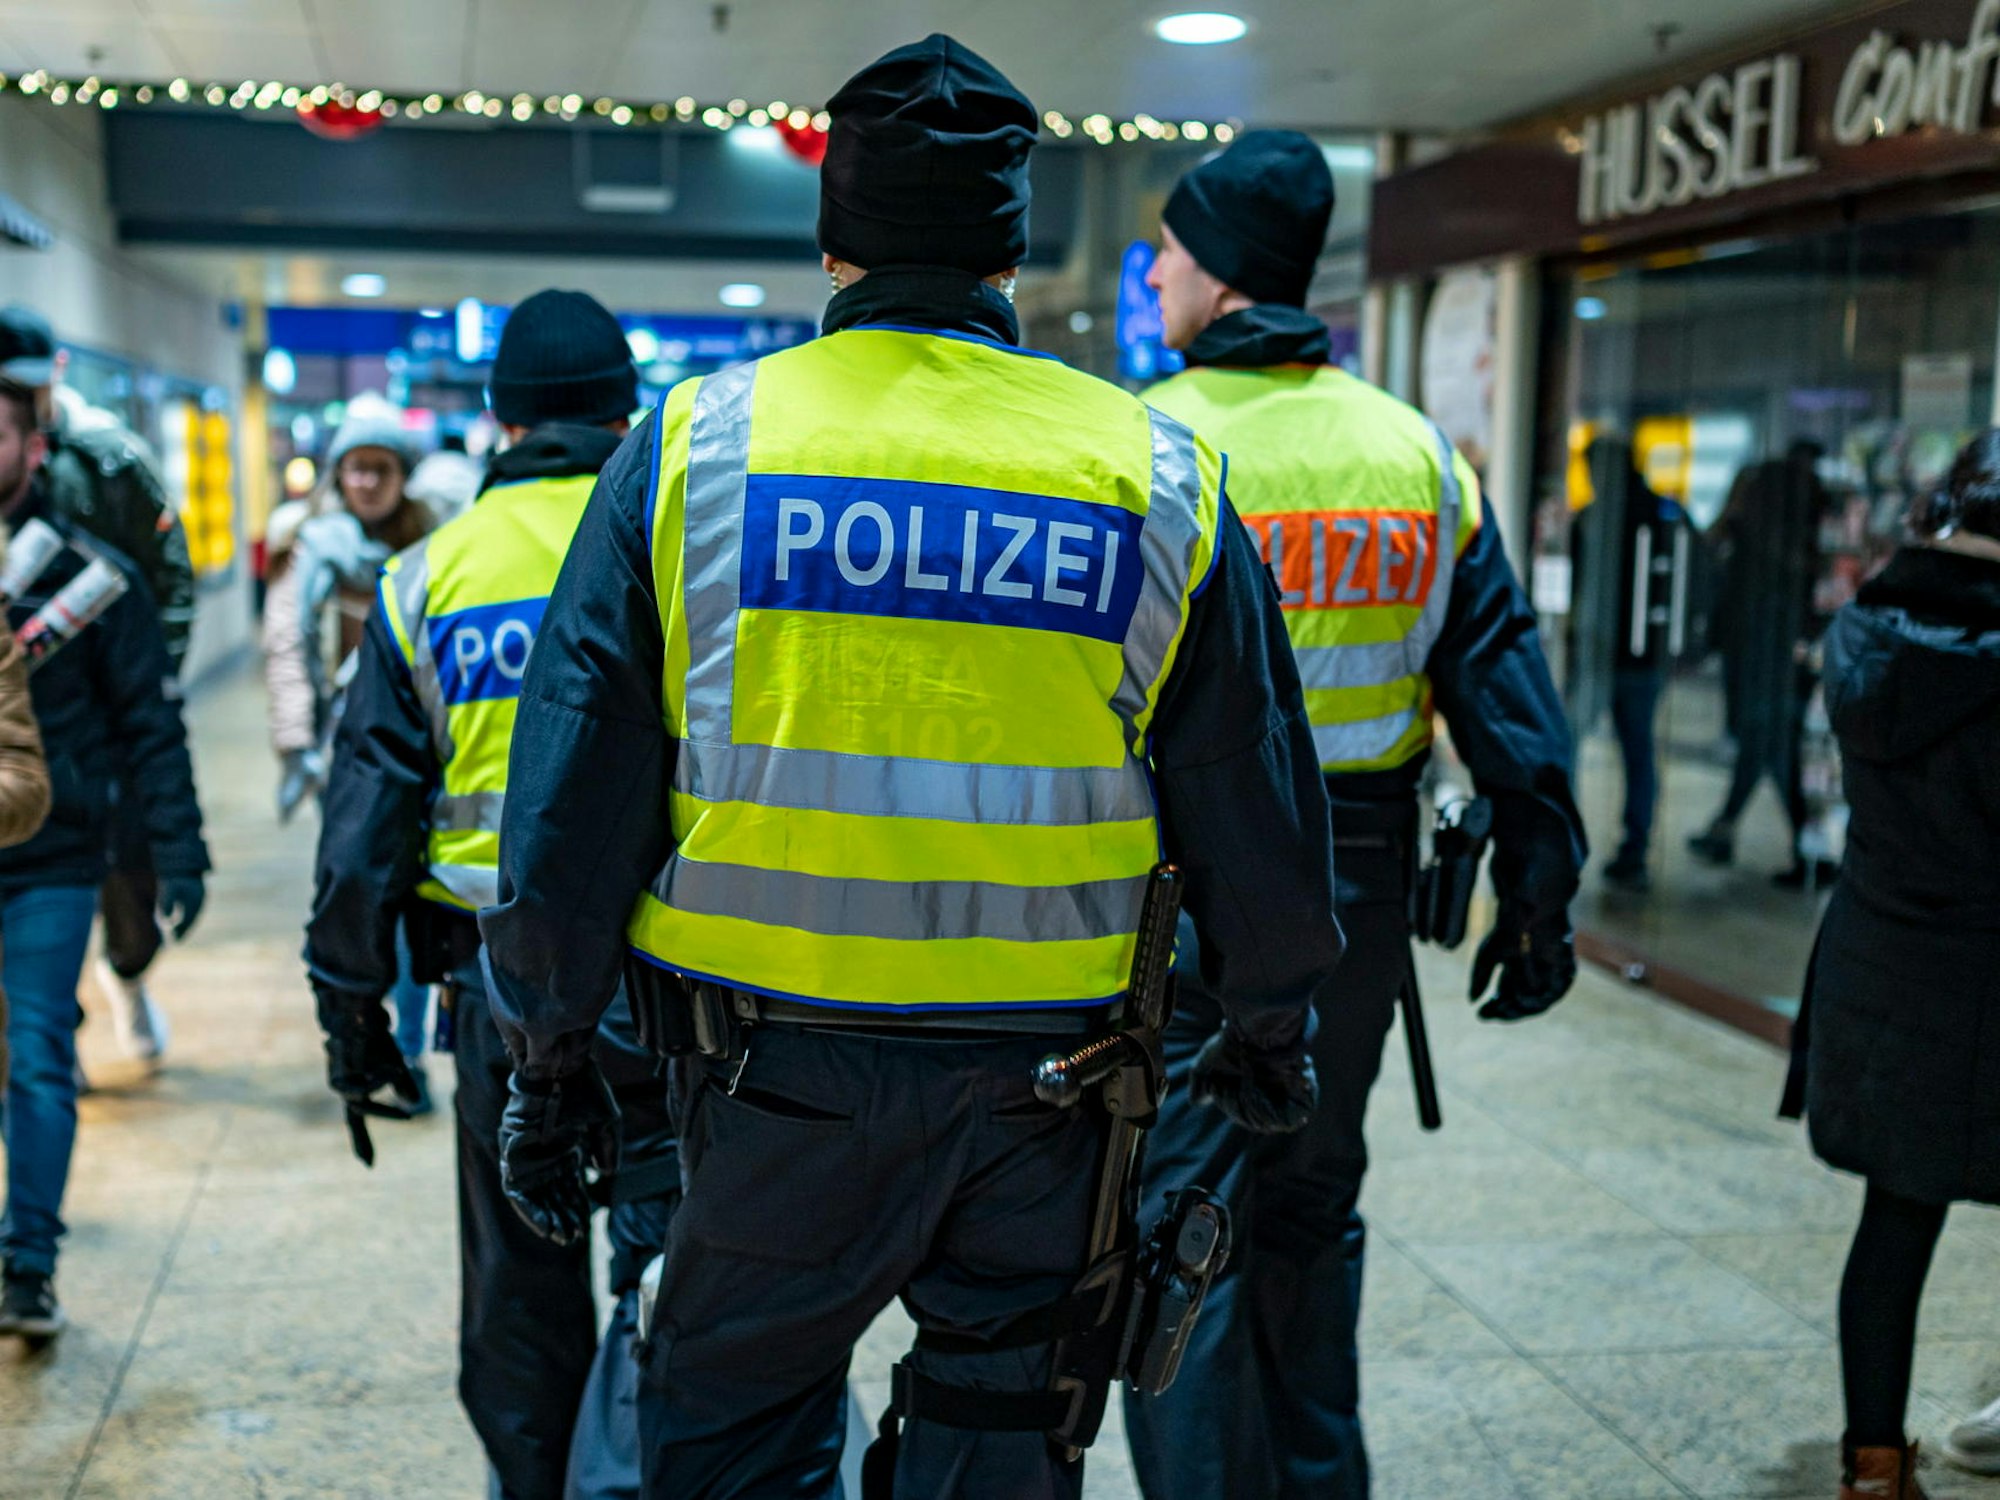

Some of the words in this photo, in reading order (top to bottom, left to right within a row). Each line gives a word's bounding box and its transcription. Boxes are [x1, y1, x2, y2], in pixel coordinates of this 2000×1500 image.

[1578, 53, 1820, 225] HUSSEL
[1834, 0, 2000, 144] Conf
[774, 498, 1120, 613] POLIZEI
[1245, 517, 1429, 604] LIZEI
